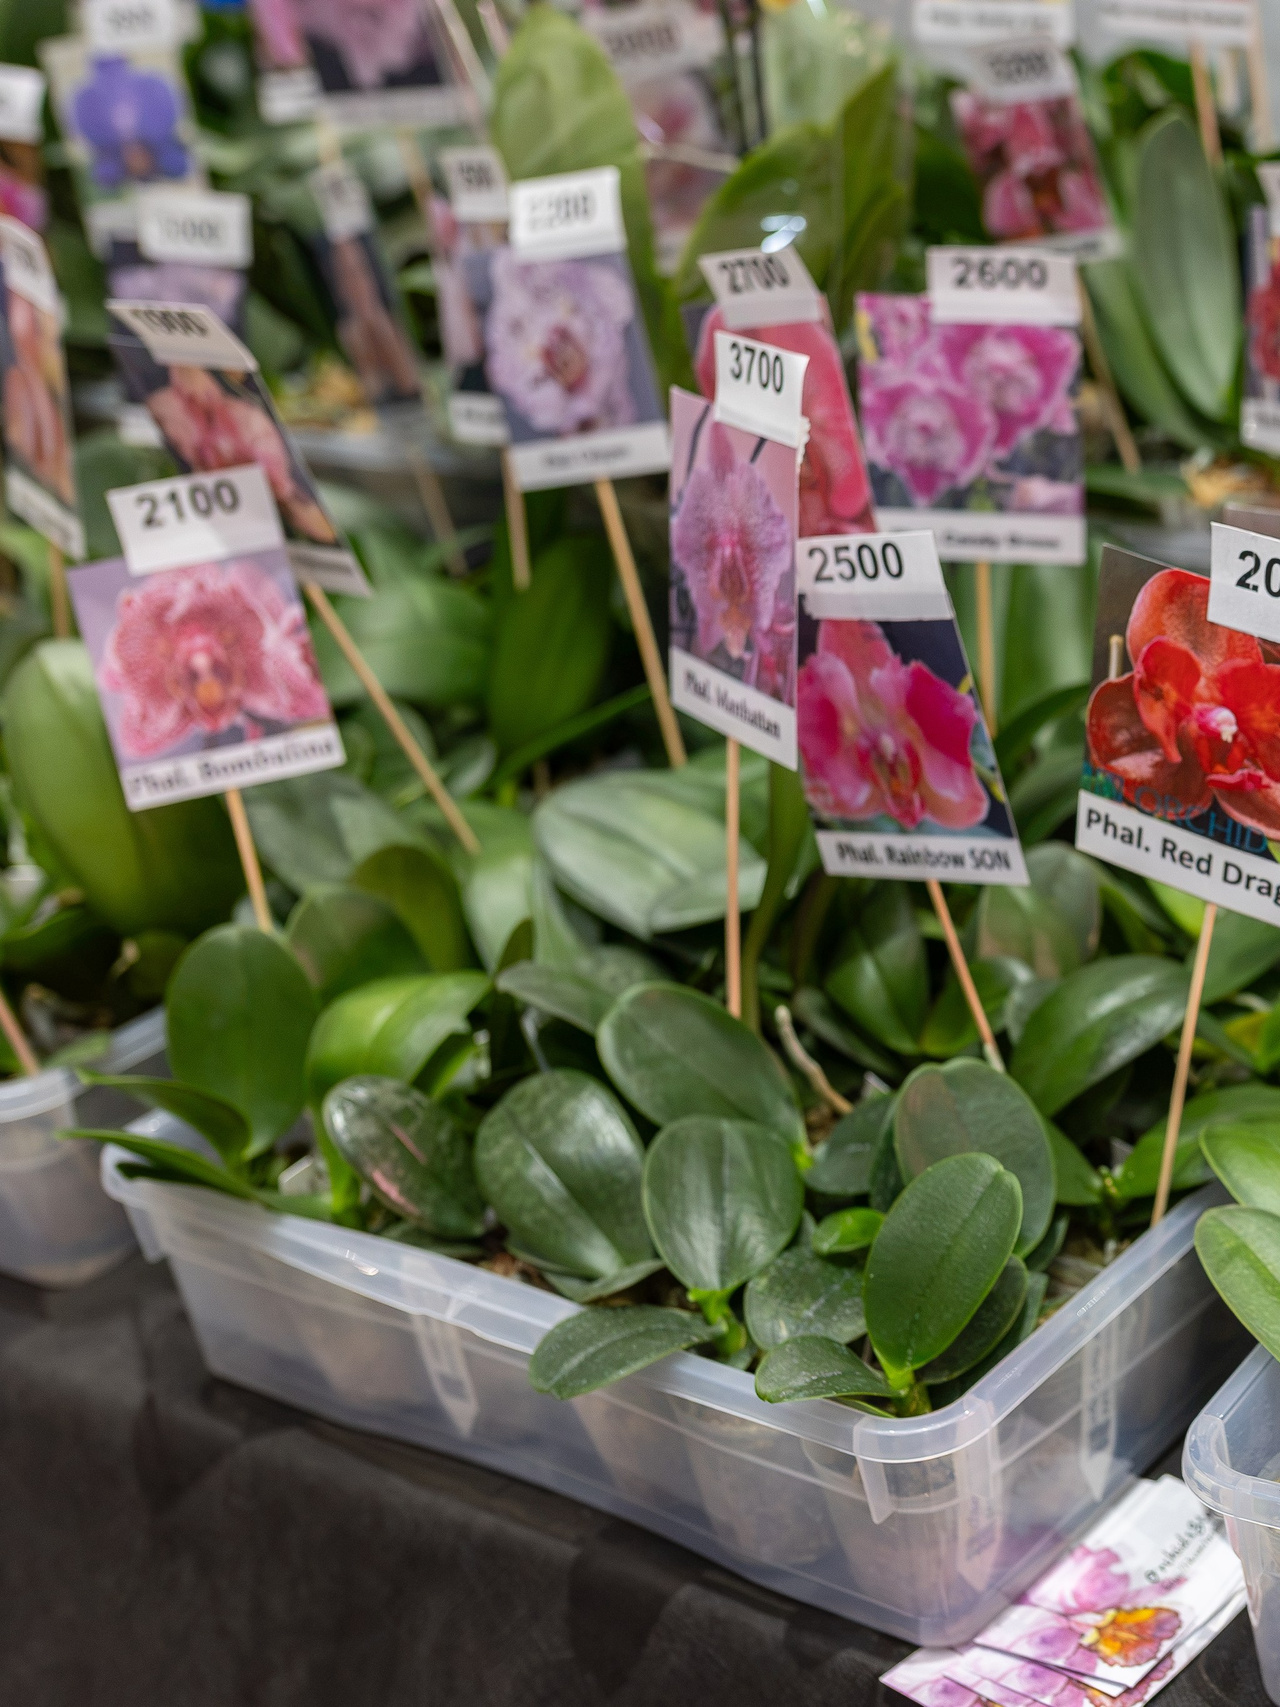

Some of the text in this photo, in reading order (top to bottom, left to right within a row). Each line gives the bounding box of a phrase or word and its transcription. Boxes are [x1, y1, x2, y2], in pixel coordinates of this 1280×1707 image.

[719, 256, 791, 294] 2700
[953, 255, 1049, 291] 2600
[730, 341, 785, 394] 3700
[135, 478, 240, 529] 2100
[808, 542, 904, 582] 2500
[836, 842, 1012, 871] Phal. Rainbow SON
[1086, 808, 1149, 852] Phal.
[1160, 837, 1213, 877] Red
